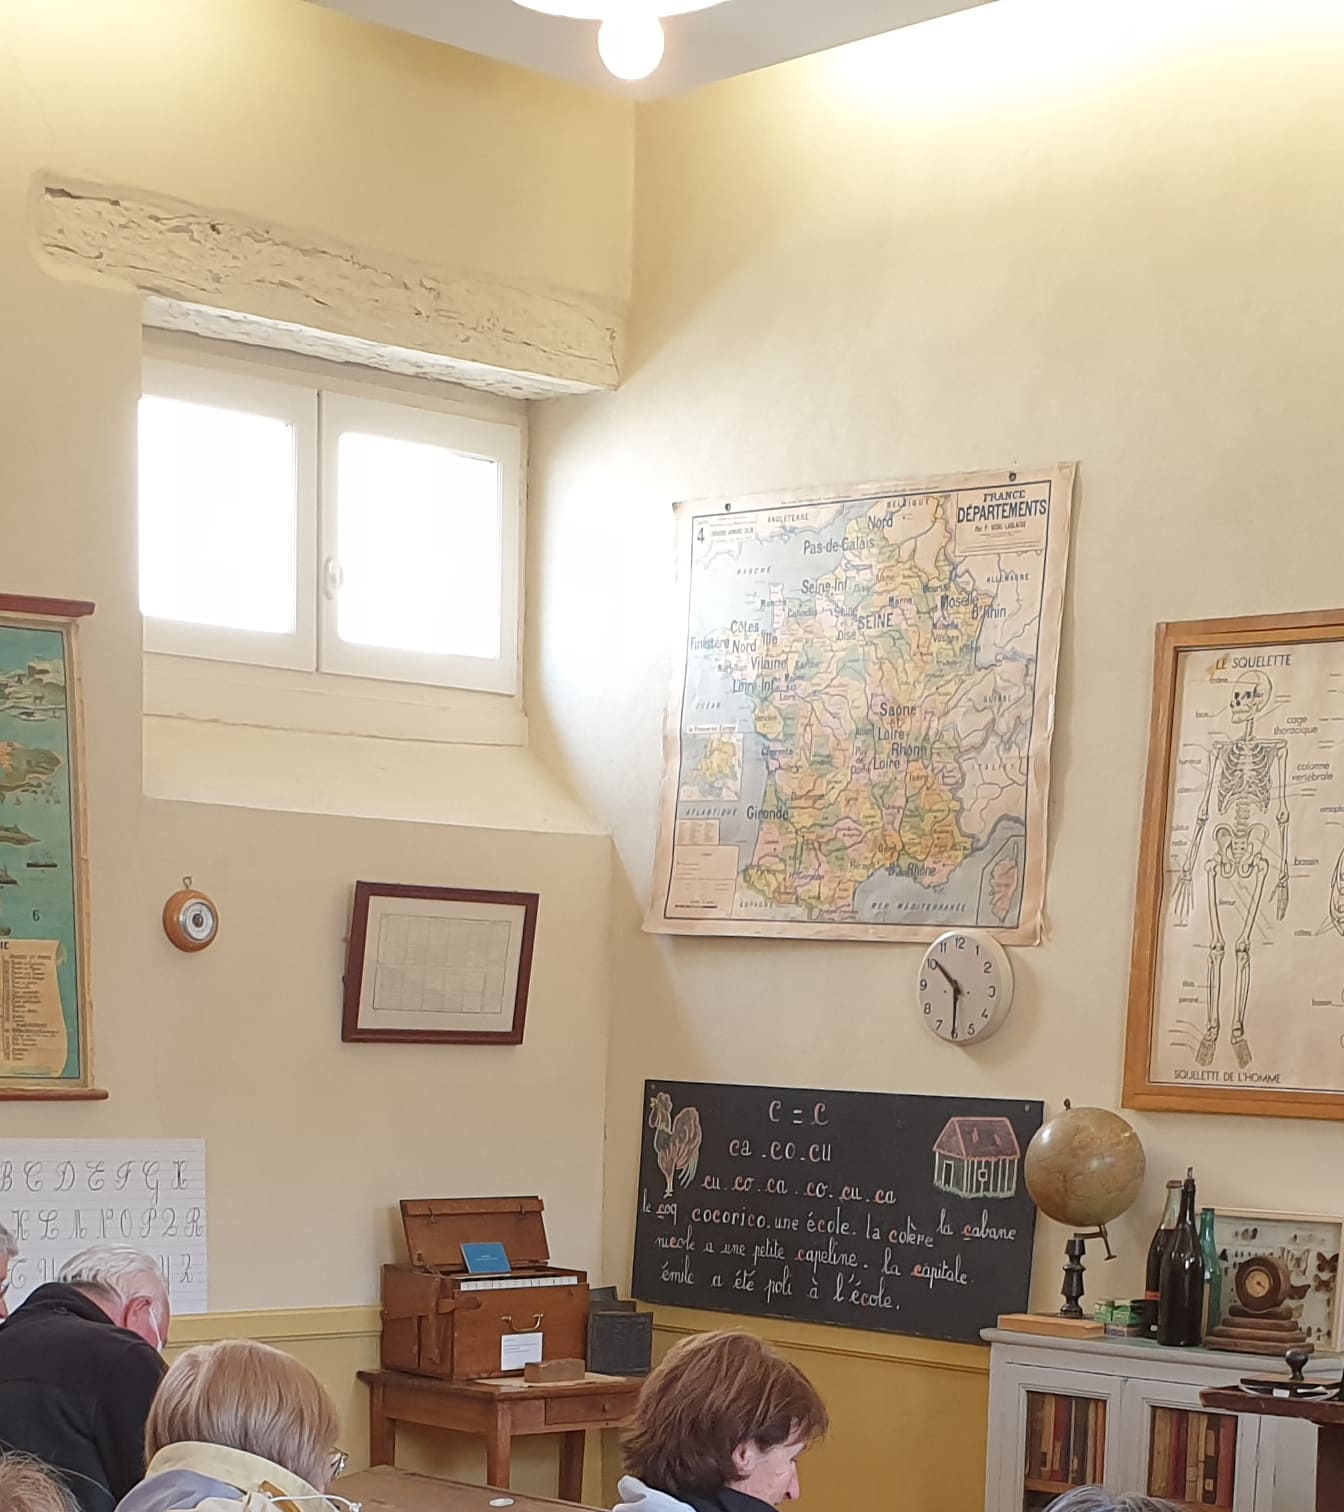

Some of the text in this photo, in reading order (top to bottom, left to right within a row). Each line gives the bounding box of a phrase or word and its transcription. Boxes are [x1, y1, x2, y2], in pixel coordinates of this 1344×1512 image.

[983, 490, 1026, 502] FRANCE
[957, 499, 1047, 523] DÉPARTEMENTS
[867, 515, 894, 529] Nord
[697, 527, 705, 544] 4
[803, 537, 875, 555] Pas-de-Calais
[730, 620, 760, 633] Côtes
[858, 613, 894, 630] SEINE
[732, 639, 757, 653] Nord
[1216, 654, 1292, 670] LE SQUELETTE
[878, 728, 905, 741] Loire
[873, 757, 900, 770] Loire
[746, 805, 789, 820] Gironde
[940, 942, 947, 954] 11
[955, 937, 966, 949] 12
[927, 958, 937, 970] 10
[984, 961, 992, 974] 2
[920, 979, 927, 991] 9
[924, 1003, 931, 1015] 8
[981, 1008, 988, 1019] 4
[936, 1020, 943, 1031] 7
[968, 1023, 975, 1035] 5
[1174, 1069, 1281, 1083] SQUELETTE DE L'HOMME
[656, 1203, 678, 1227] coq
[774, 1217, 799, 1231] une
[866, 1212, 880, 1240] la
[888, 1216, 935, 1248] colère
[936, 1208, 1016, 1241] la cabane
[655, 1224, 697, 1251] nicole
[703, 1241, 714, 1253] a
[720, 1245, 746, 1257] une
[753, 1238, 785, 1266] petite
[881, 1247, 901, 1276] la
[660, 1254, 696, 1285] émile
[710, 1274, 723, 1288] a
[733, 1270, 755, 1292] été
[765, 1265, 793, 1304] poli
[807, 1276, 819, 1300] à
